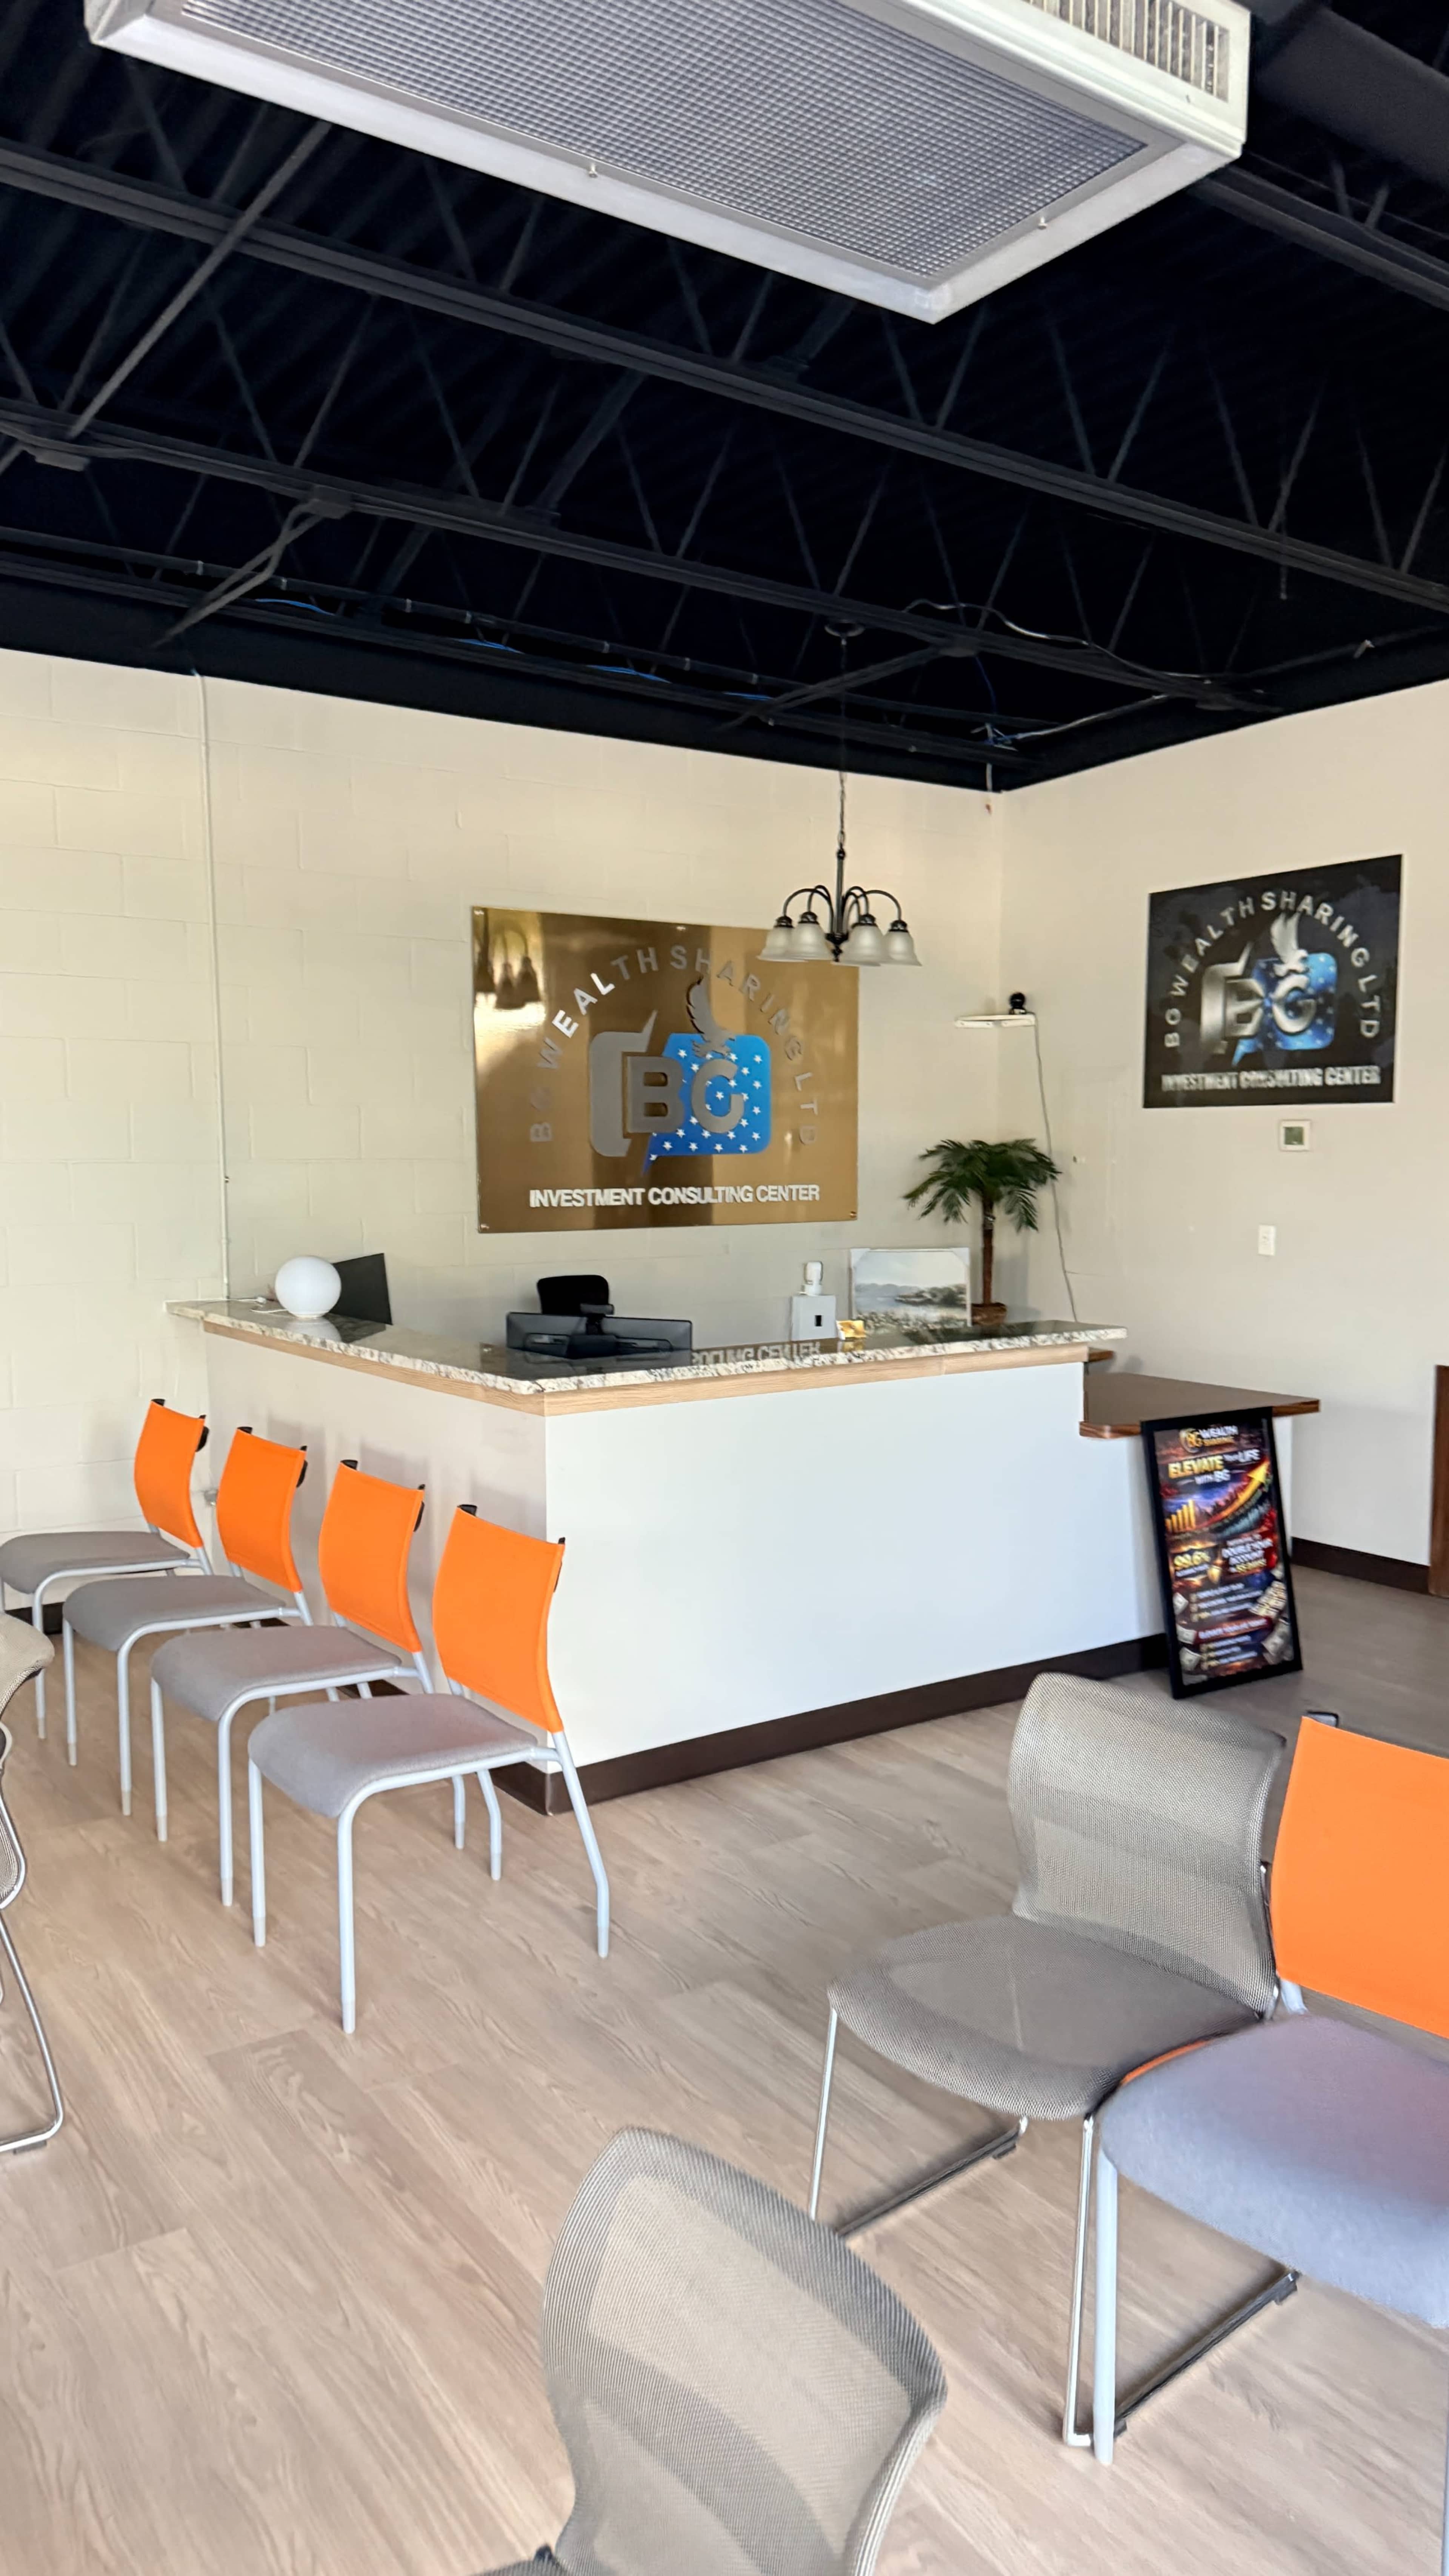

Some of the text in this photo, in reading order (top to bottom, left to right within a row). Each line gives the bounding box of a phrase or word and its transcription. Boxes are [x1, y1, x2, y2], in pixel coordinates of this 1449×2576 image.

[1169, 897, 1255, 996] WEALTH
[1261, 890, 1370, 967] SHARING
[1358, 974, 1381, 1038] LTD
[536, 946, 659, 1070] WEALTH
[670, 945, 803, 1061] SHARING
[794, 1072, 819, 1145] LTD
[627, 1056, 745, 1133] BG
[1161, 1065, 1381, 1092] INVESTMENT CONSULTING CENTER
[529, 1184, 820, 1207] INVESTMENT CONSULTING CENTER
[1168, 1455, 1224, 1479] ELEVATE
[1238, 1448, 1261, 1463] LIFE
